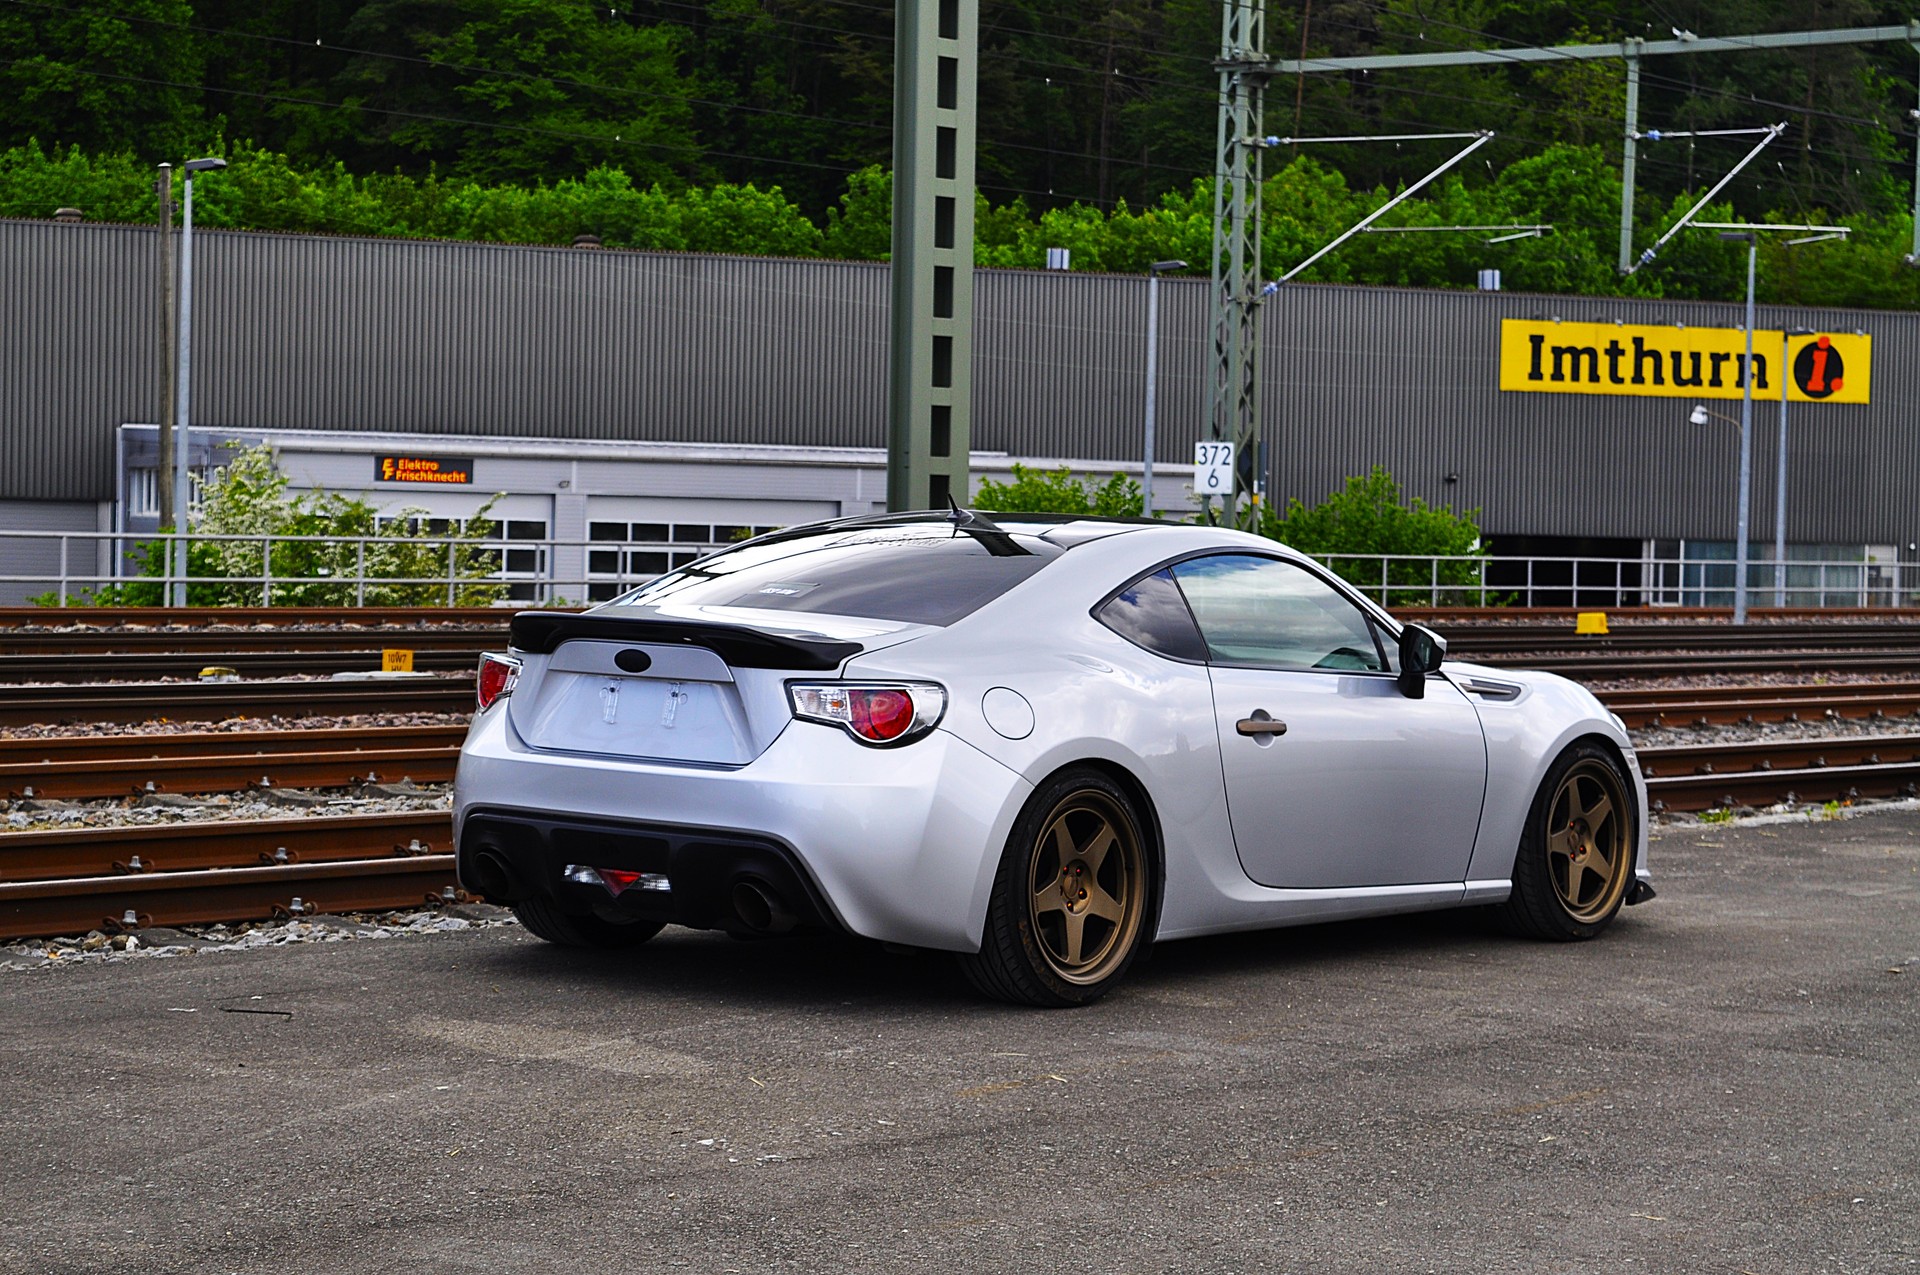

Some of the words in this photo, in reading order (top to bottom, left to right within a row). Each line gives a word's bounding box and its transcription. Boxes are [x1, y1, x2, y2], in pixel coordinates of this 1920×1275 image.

[1528, 334, 1769, 389] Imthurn
[398, 458, 440, 471] Elektro
[1198, 445, 1231, 466] 372
[396, 470, 467, 482] Frischknecht
[1207, 468, 1219, 488] 6
